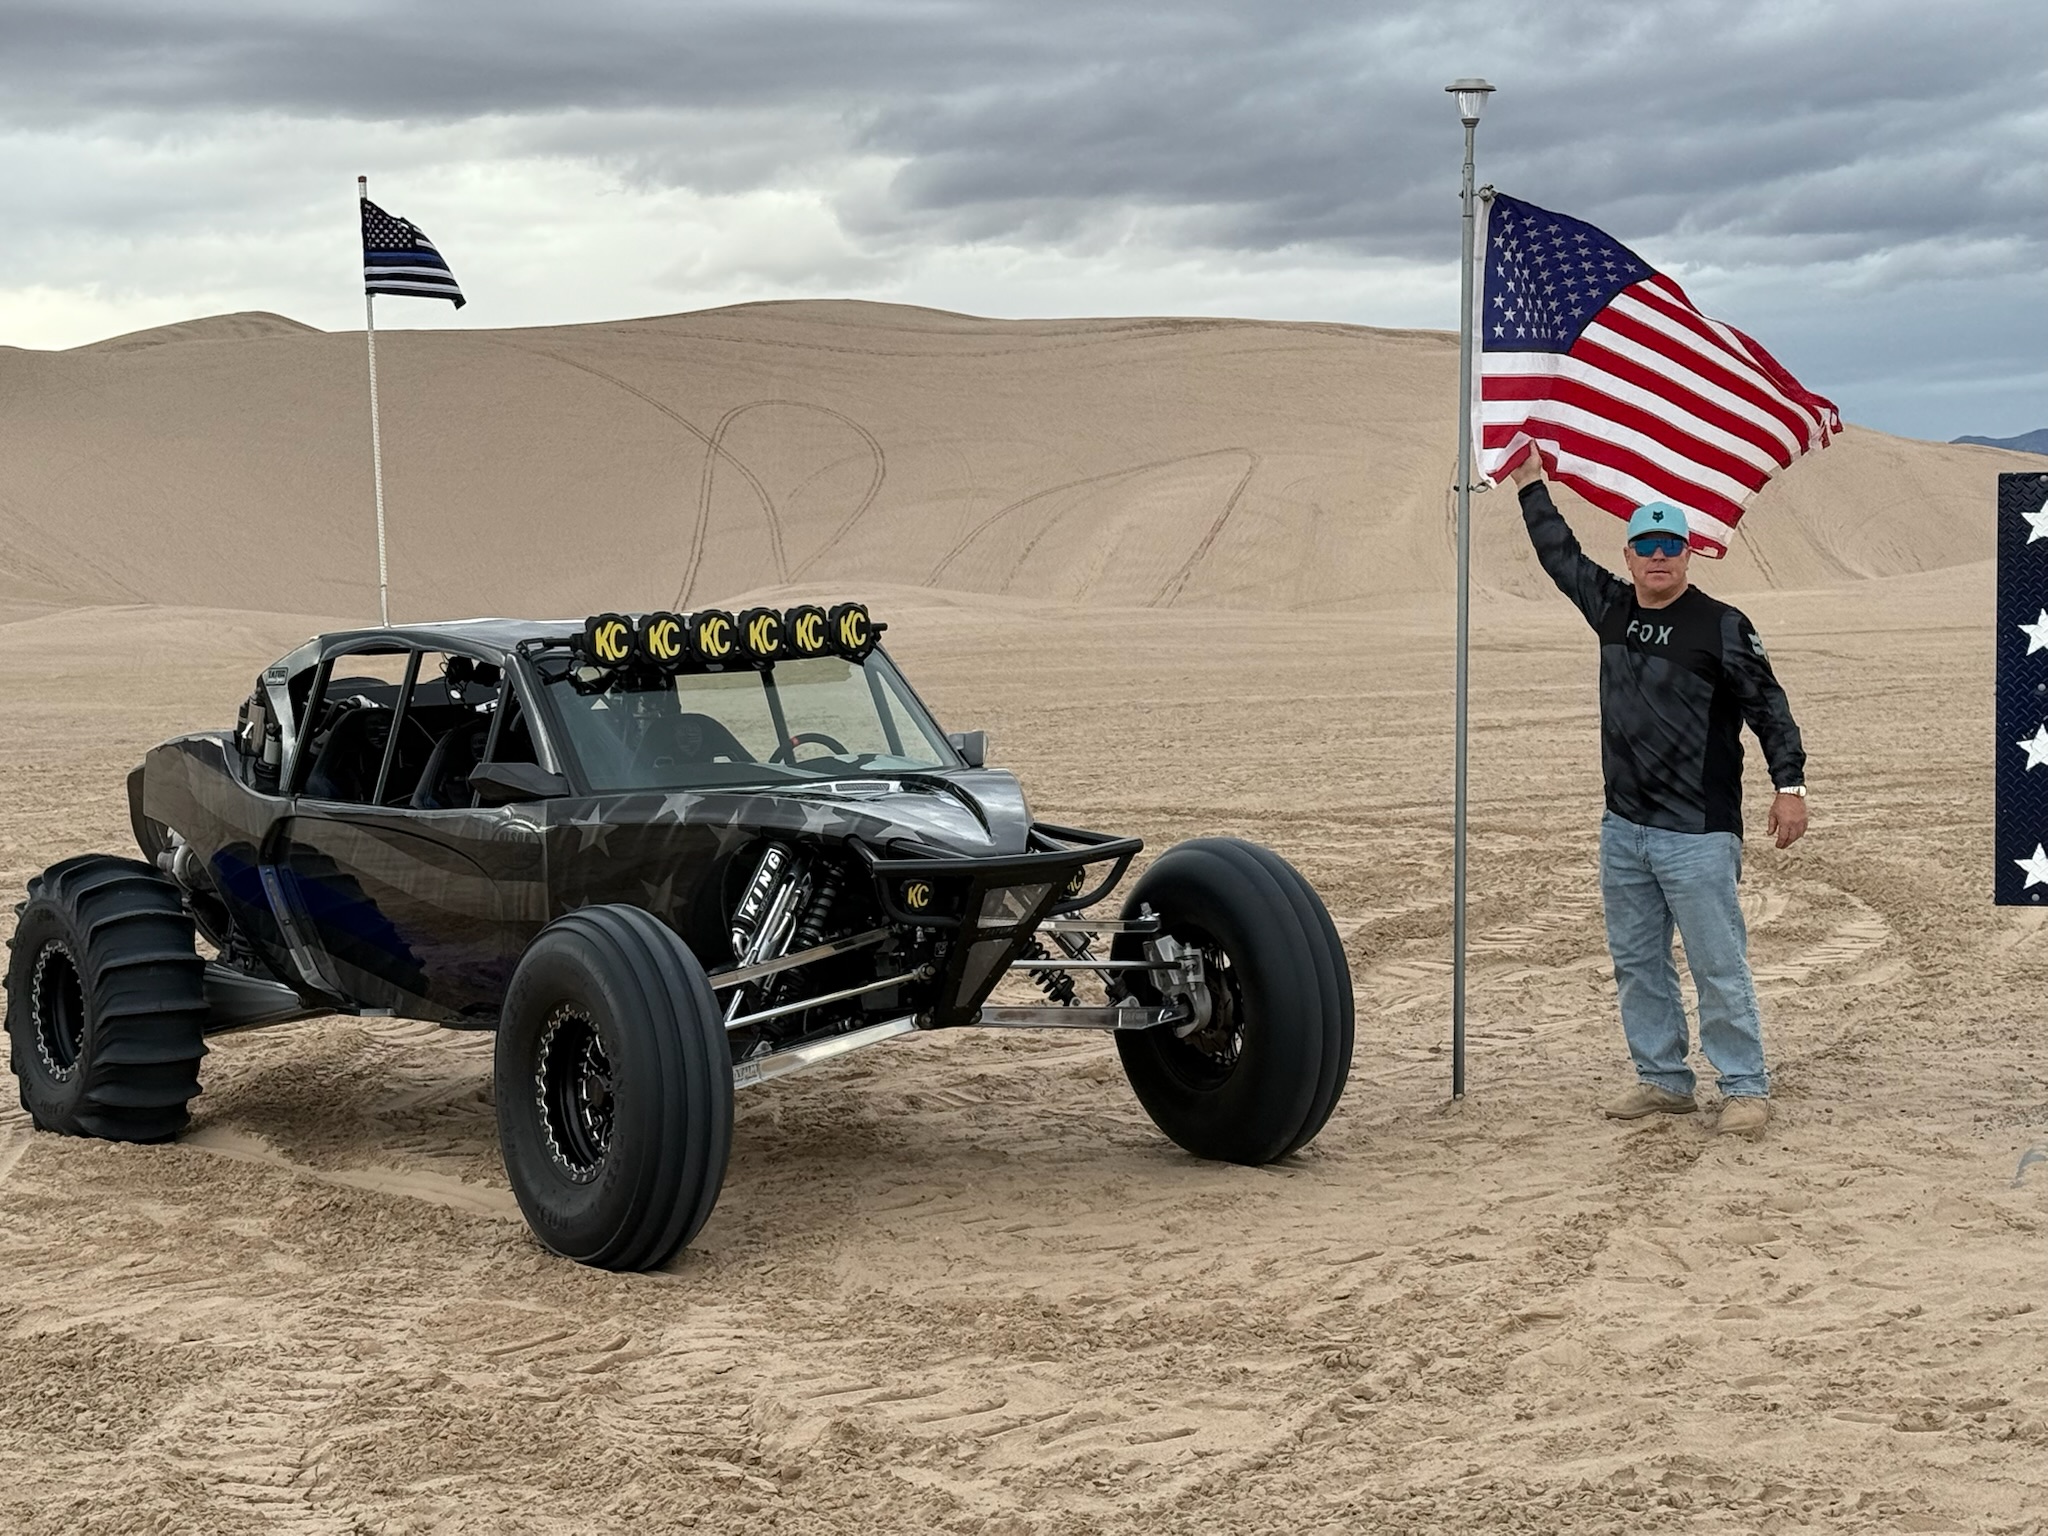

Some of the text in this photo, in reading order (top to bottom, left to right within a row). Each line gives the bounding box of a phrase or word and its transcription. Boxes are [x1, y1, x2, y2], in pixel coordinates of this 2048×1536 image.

[595, 621, 628, 661] KC
[649, 619, 680, 659] KC
[700, 617, 731, 657] KC
[749, 615, 778, 654] KC
[796, 612, 824, 651] KC
[840, 610, 866, 648] KC
[1626, 620, 1674, 645] FOX
[745, 852, 781, 917] KING
[907, 884, 929, 908] KC
